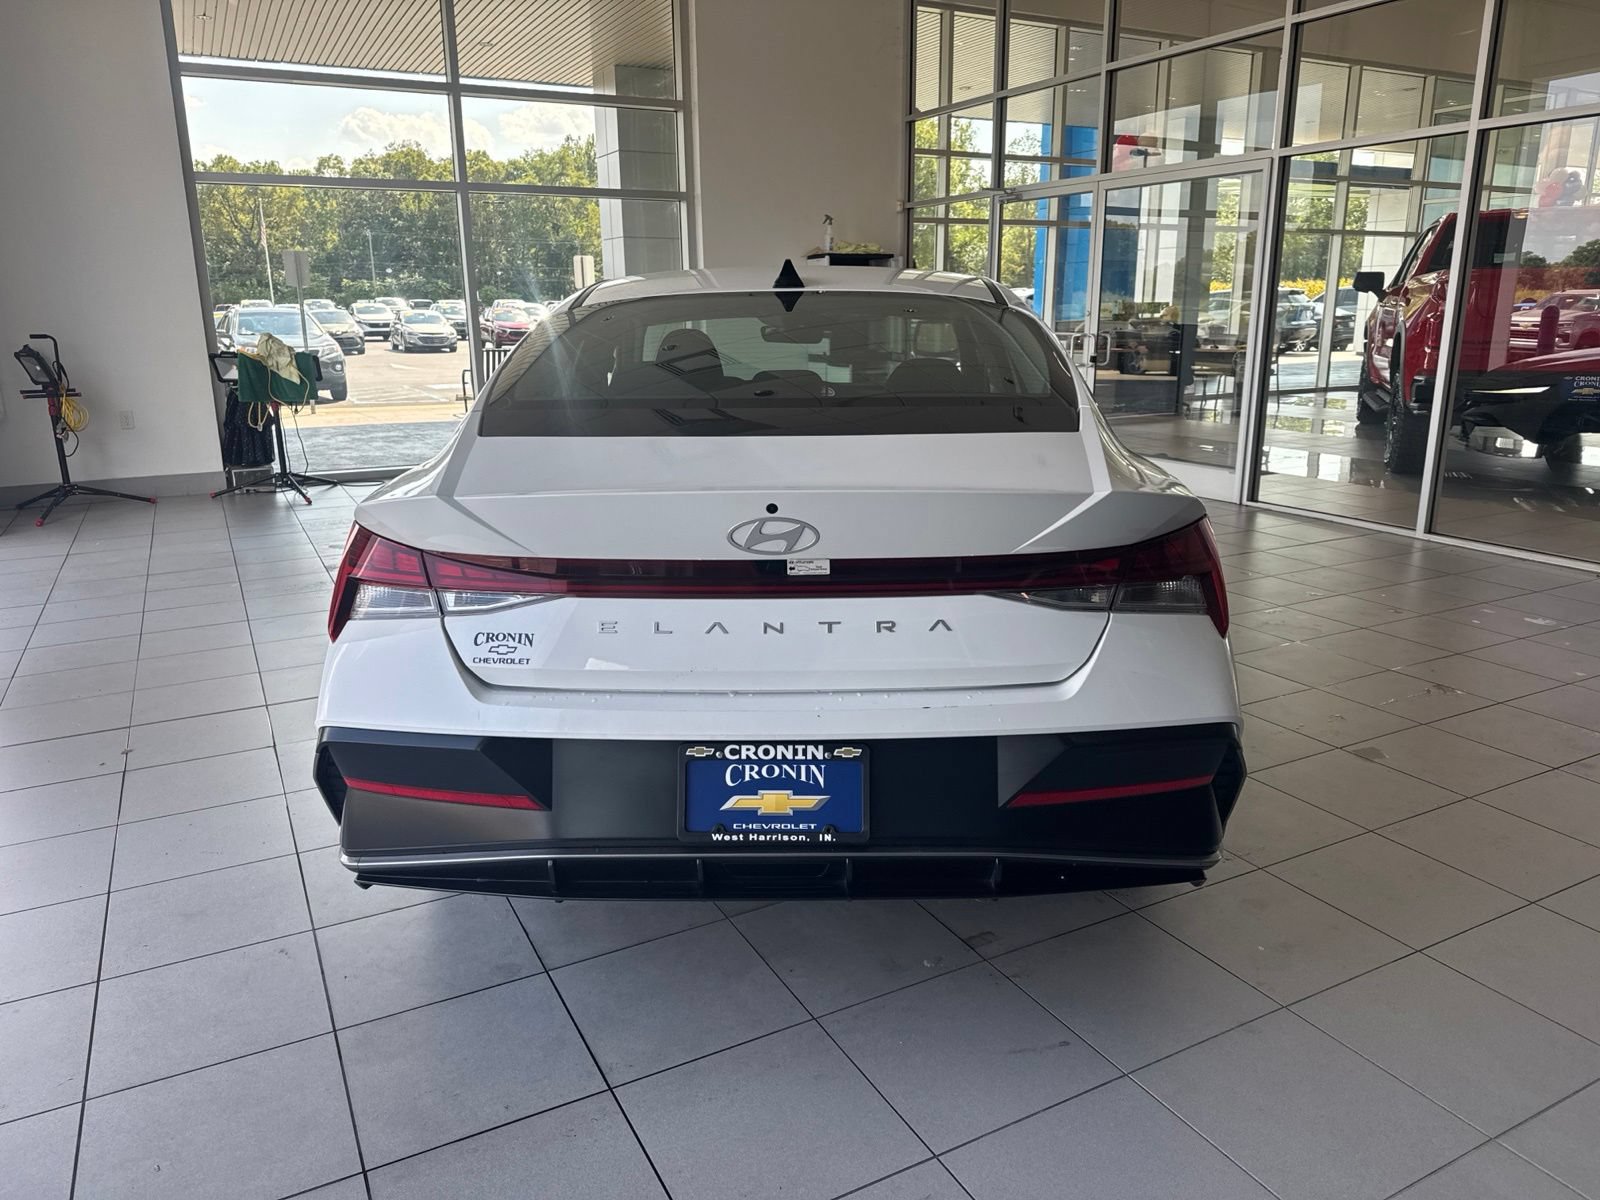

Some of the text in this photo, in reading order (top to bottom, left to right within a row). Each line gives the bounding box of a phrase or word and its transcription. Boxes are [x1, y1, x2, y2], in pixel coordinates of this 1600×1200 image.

[598, 619, 953, 635] ELANTRA
[473, 631, 535, 648] CRONIN
[472, 656, 531, 665] CHEVROLET
[723, 744, 824, 760] CRONIN
[724, 763, 827, 789] CRONIN
[711, 833, 836, 843] West Harrison, IN.
